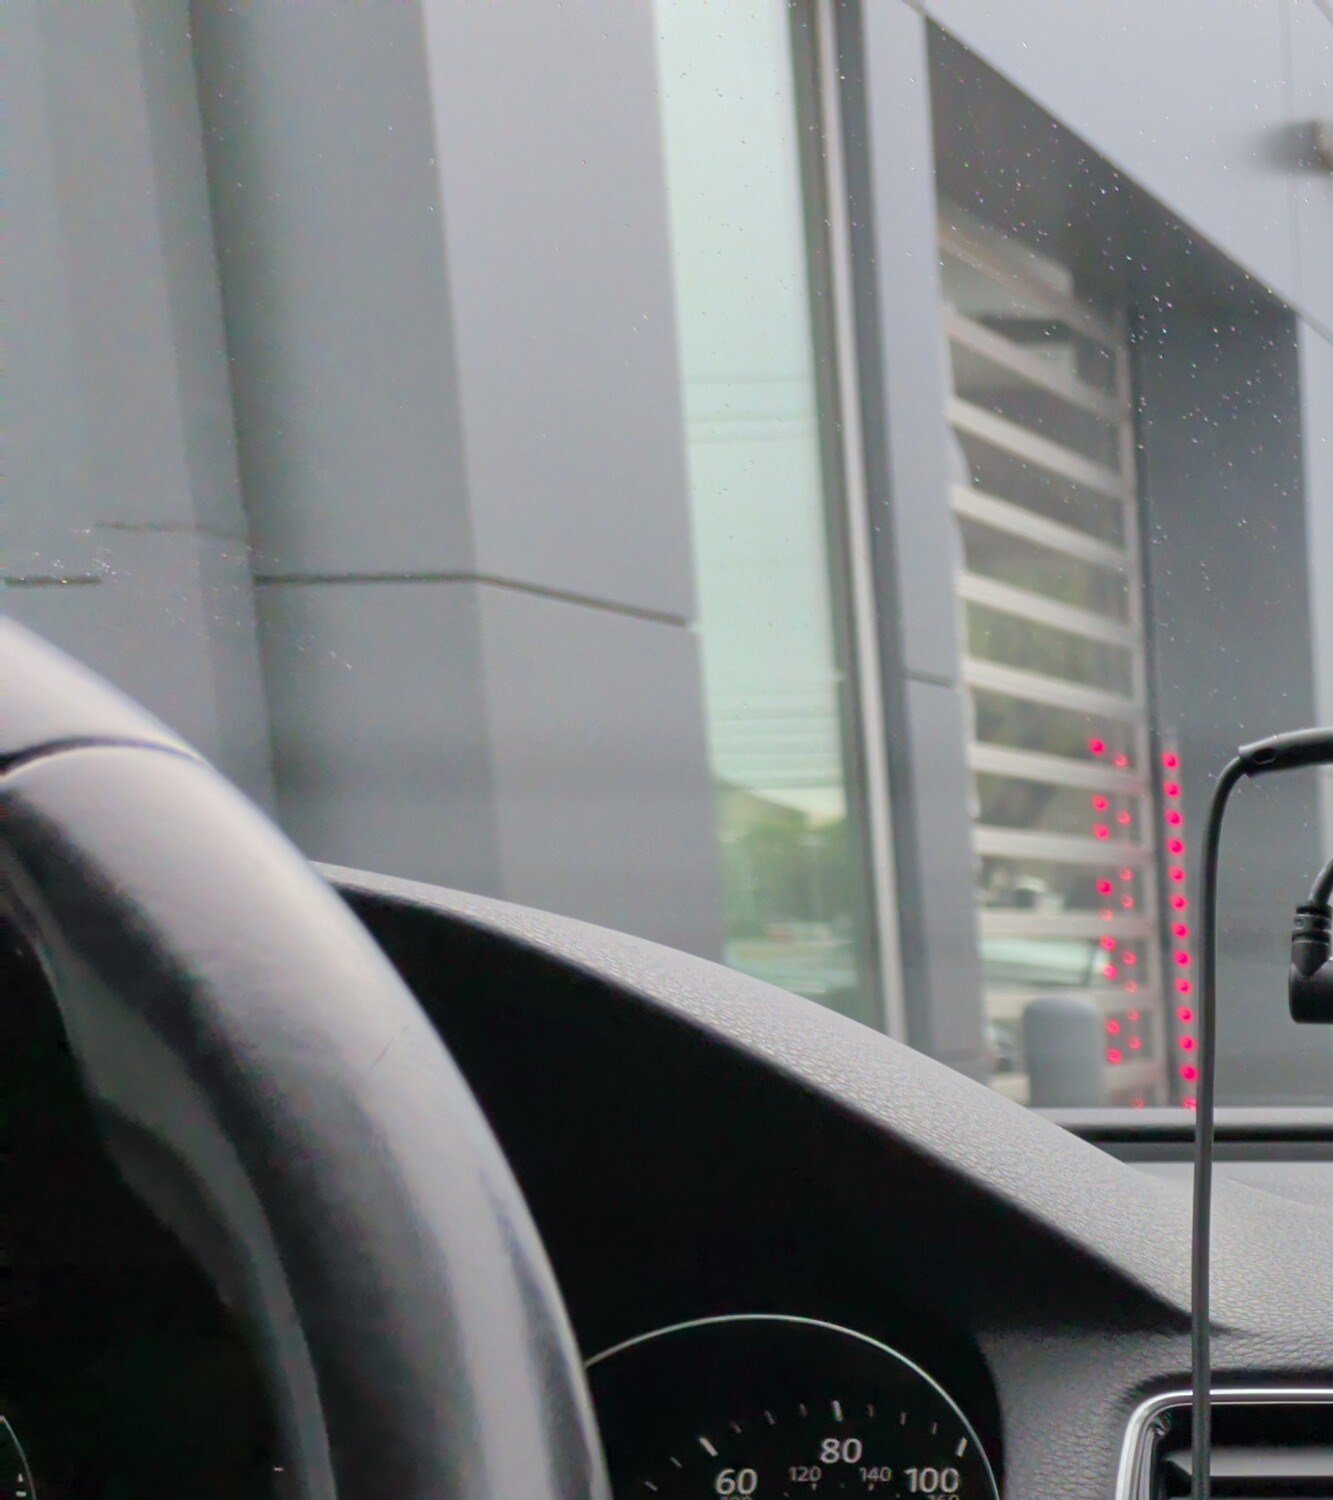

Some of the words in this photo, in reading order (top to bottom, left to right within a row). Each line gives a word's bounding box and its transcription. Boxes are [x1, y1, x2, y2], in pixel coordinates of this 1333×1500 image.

[820, 1438, 863, 1464] 80
[715, 1468, 758, 1495] 60
[789, 1466, 822, 1482] 120
[859, 1466, 893, 1482] 140
[904, 1467, 960, 1493] 100
